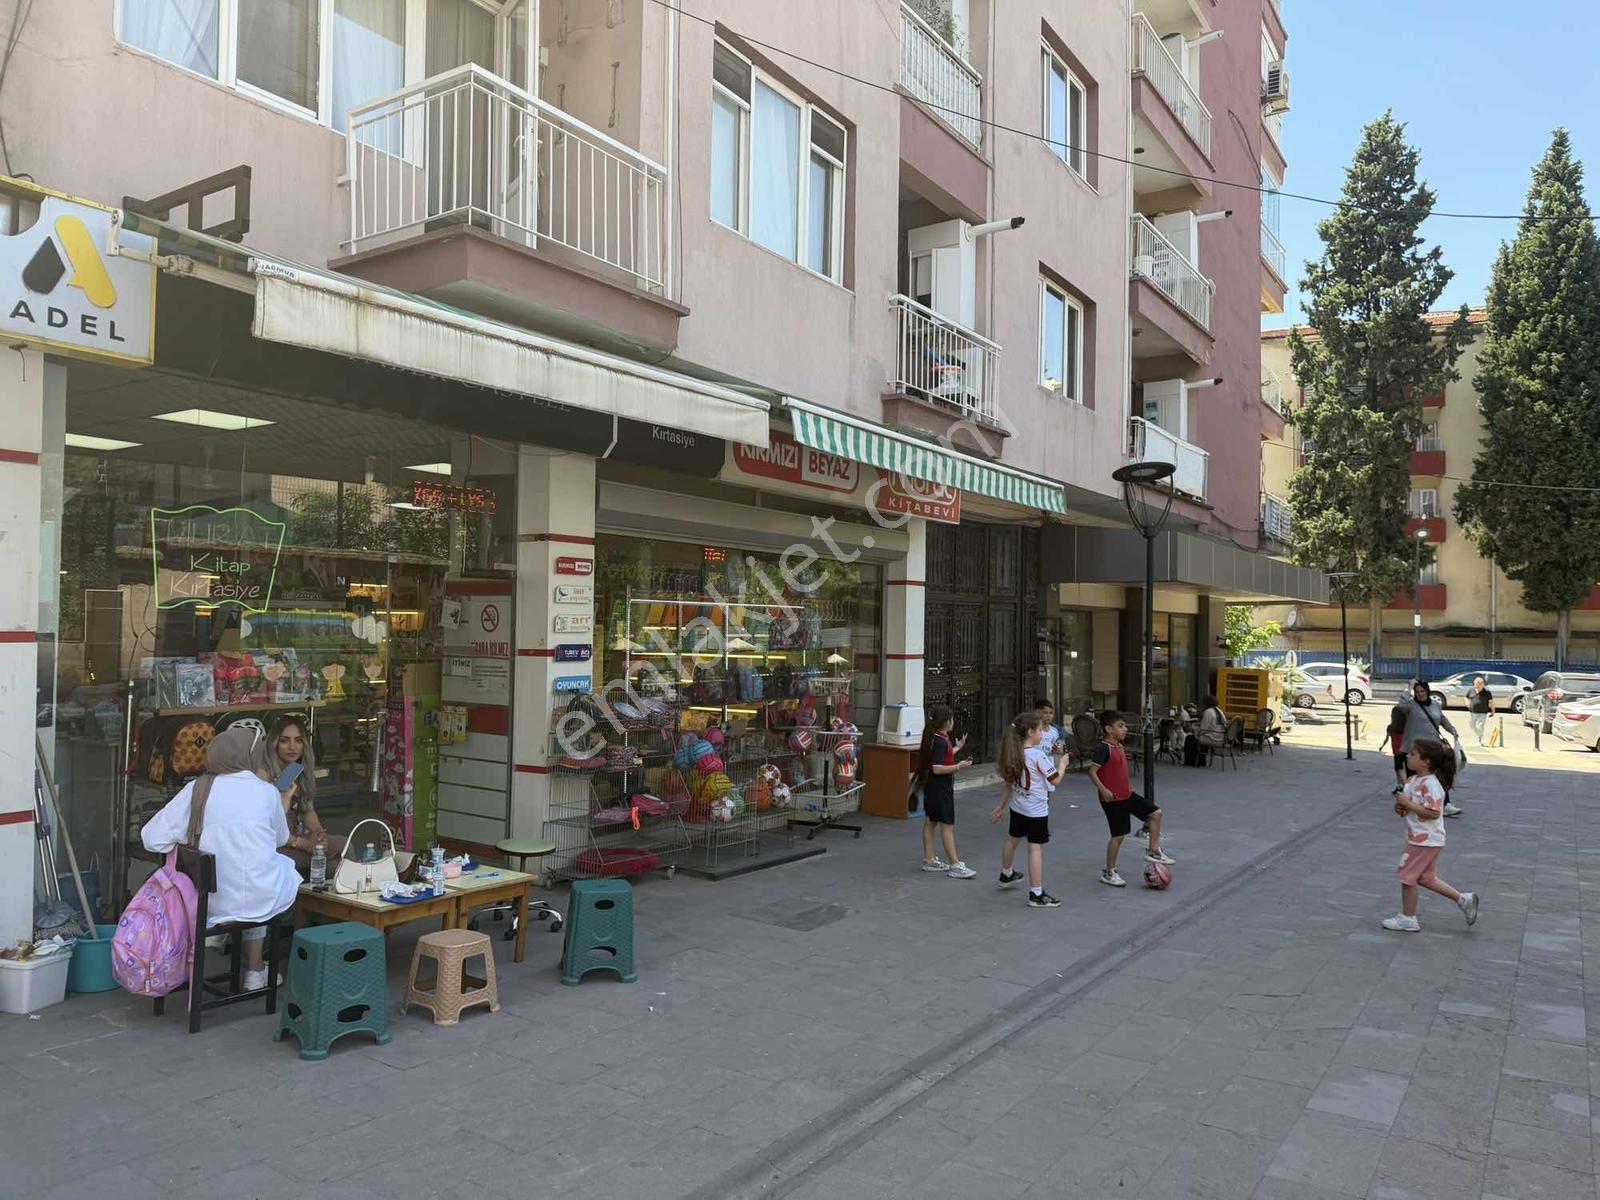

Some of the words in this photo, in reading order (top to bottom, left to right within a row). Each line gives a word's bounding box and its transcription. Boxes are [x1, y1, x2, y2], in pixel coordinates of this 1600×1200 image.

[9, 300, 126, 342] ADEL
[652, 425, 696, 448] Kırtasiye
[809, 451, 850, 480] BEYAZ
[190, 552, 251, 576] Kitap
[170, 572, 261, 601] Kırtasiye
[556, 679, 590, 690] OYUNCAK
